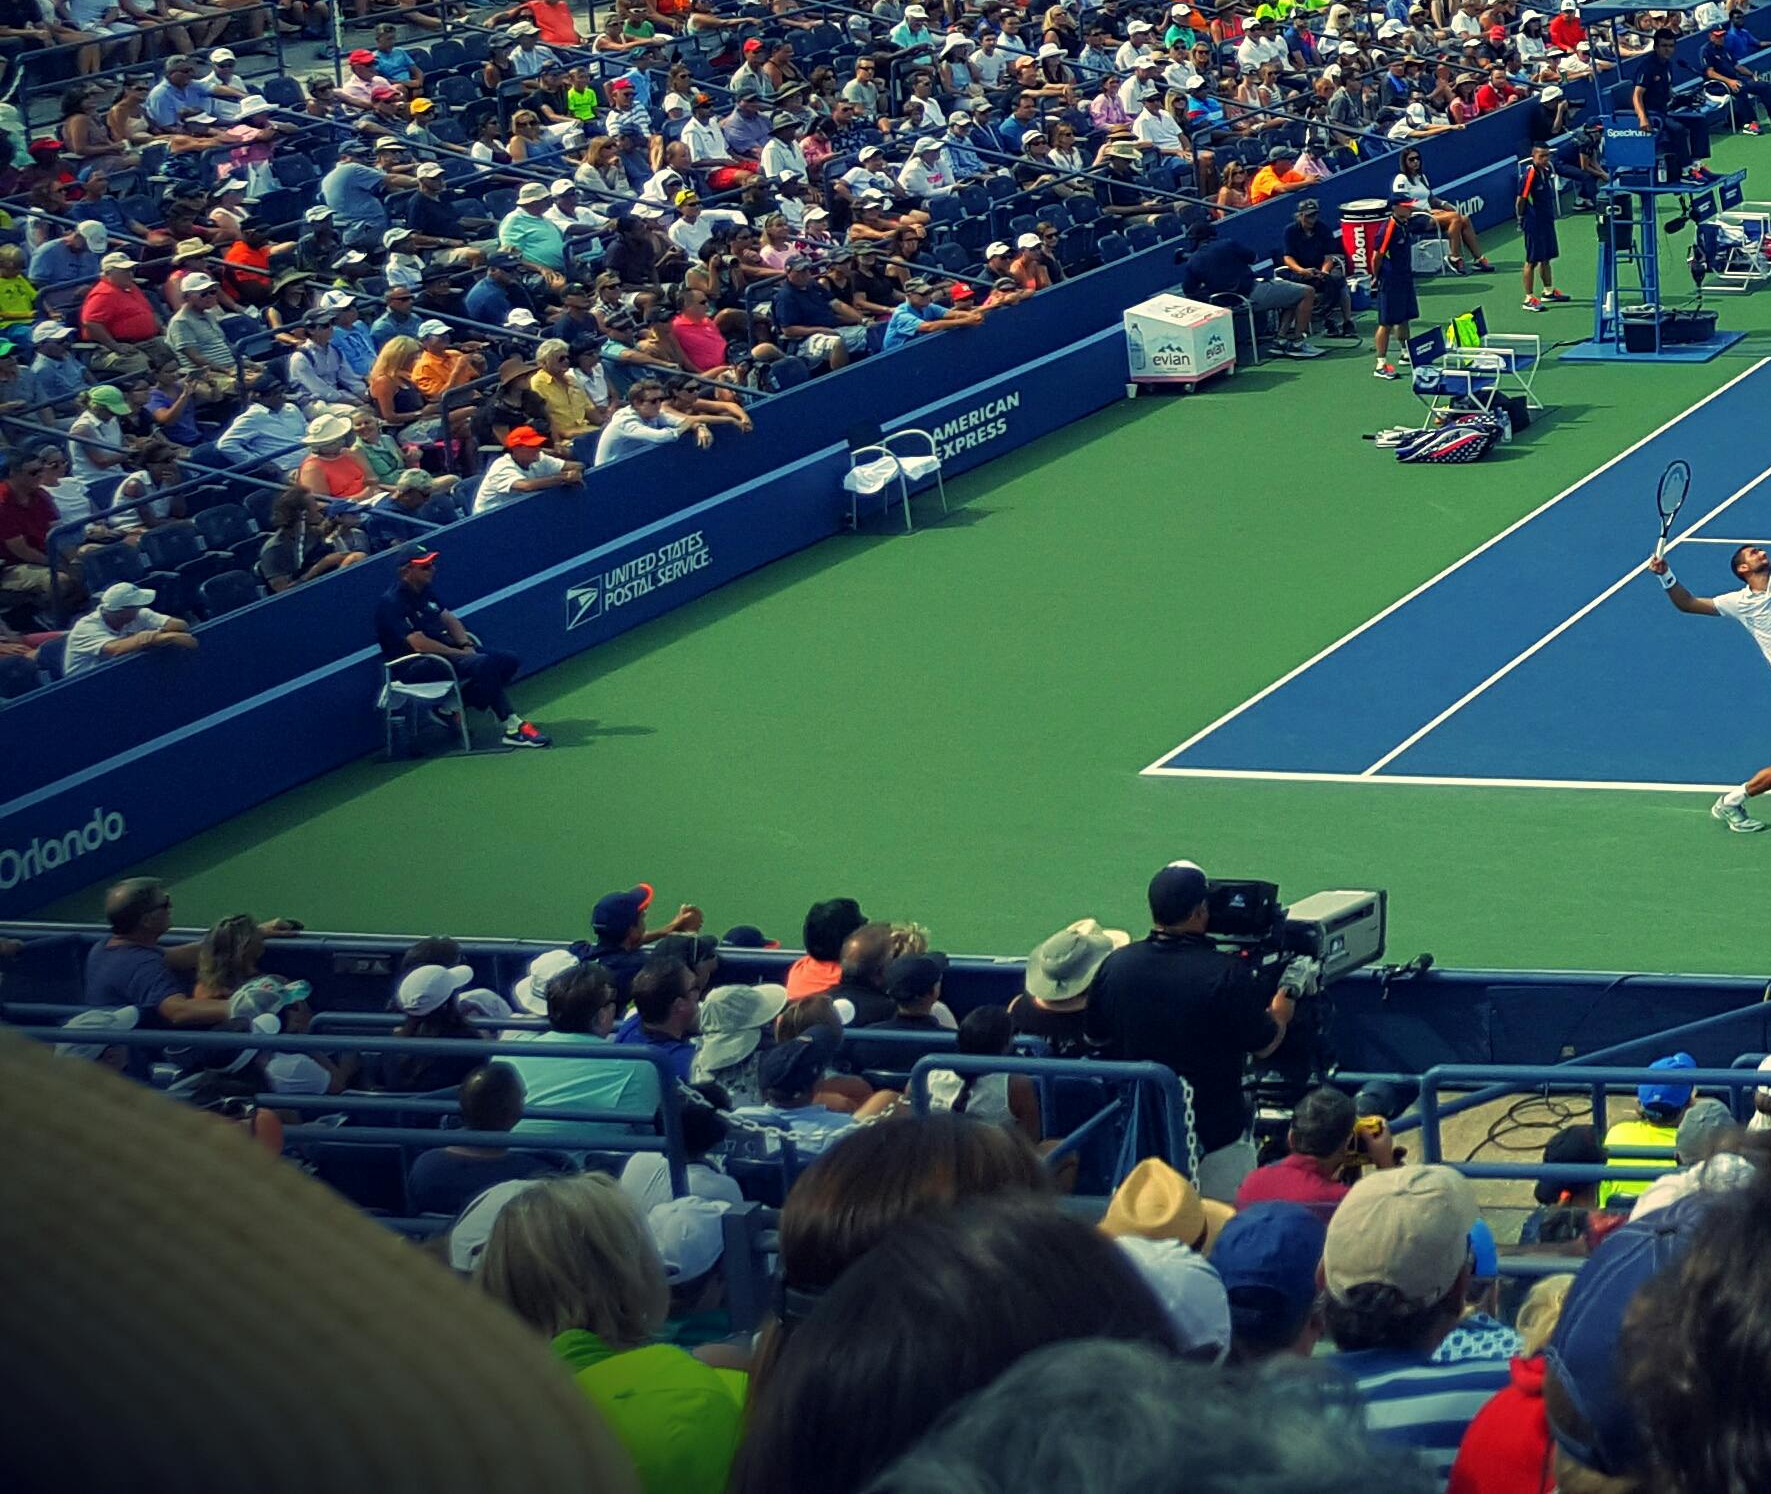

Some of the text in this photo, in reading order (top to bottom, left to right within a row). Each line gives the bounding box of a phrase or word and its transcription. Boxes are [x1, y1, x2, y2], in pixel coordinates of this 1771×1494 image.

[1152, 353, 1191, 366] evian
[1205, 343, 1226, 360] evian
[932, 391, 1020, 443] AMERICAN
[604, 530, 703, 589] UNITED STATES
[604, 547, 710, 611] POSTAL SERVICE
[0, 807, 124, 889] Orlando
